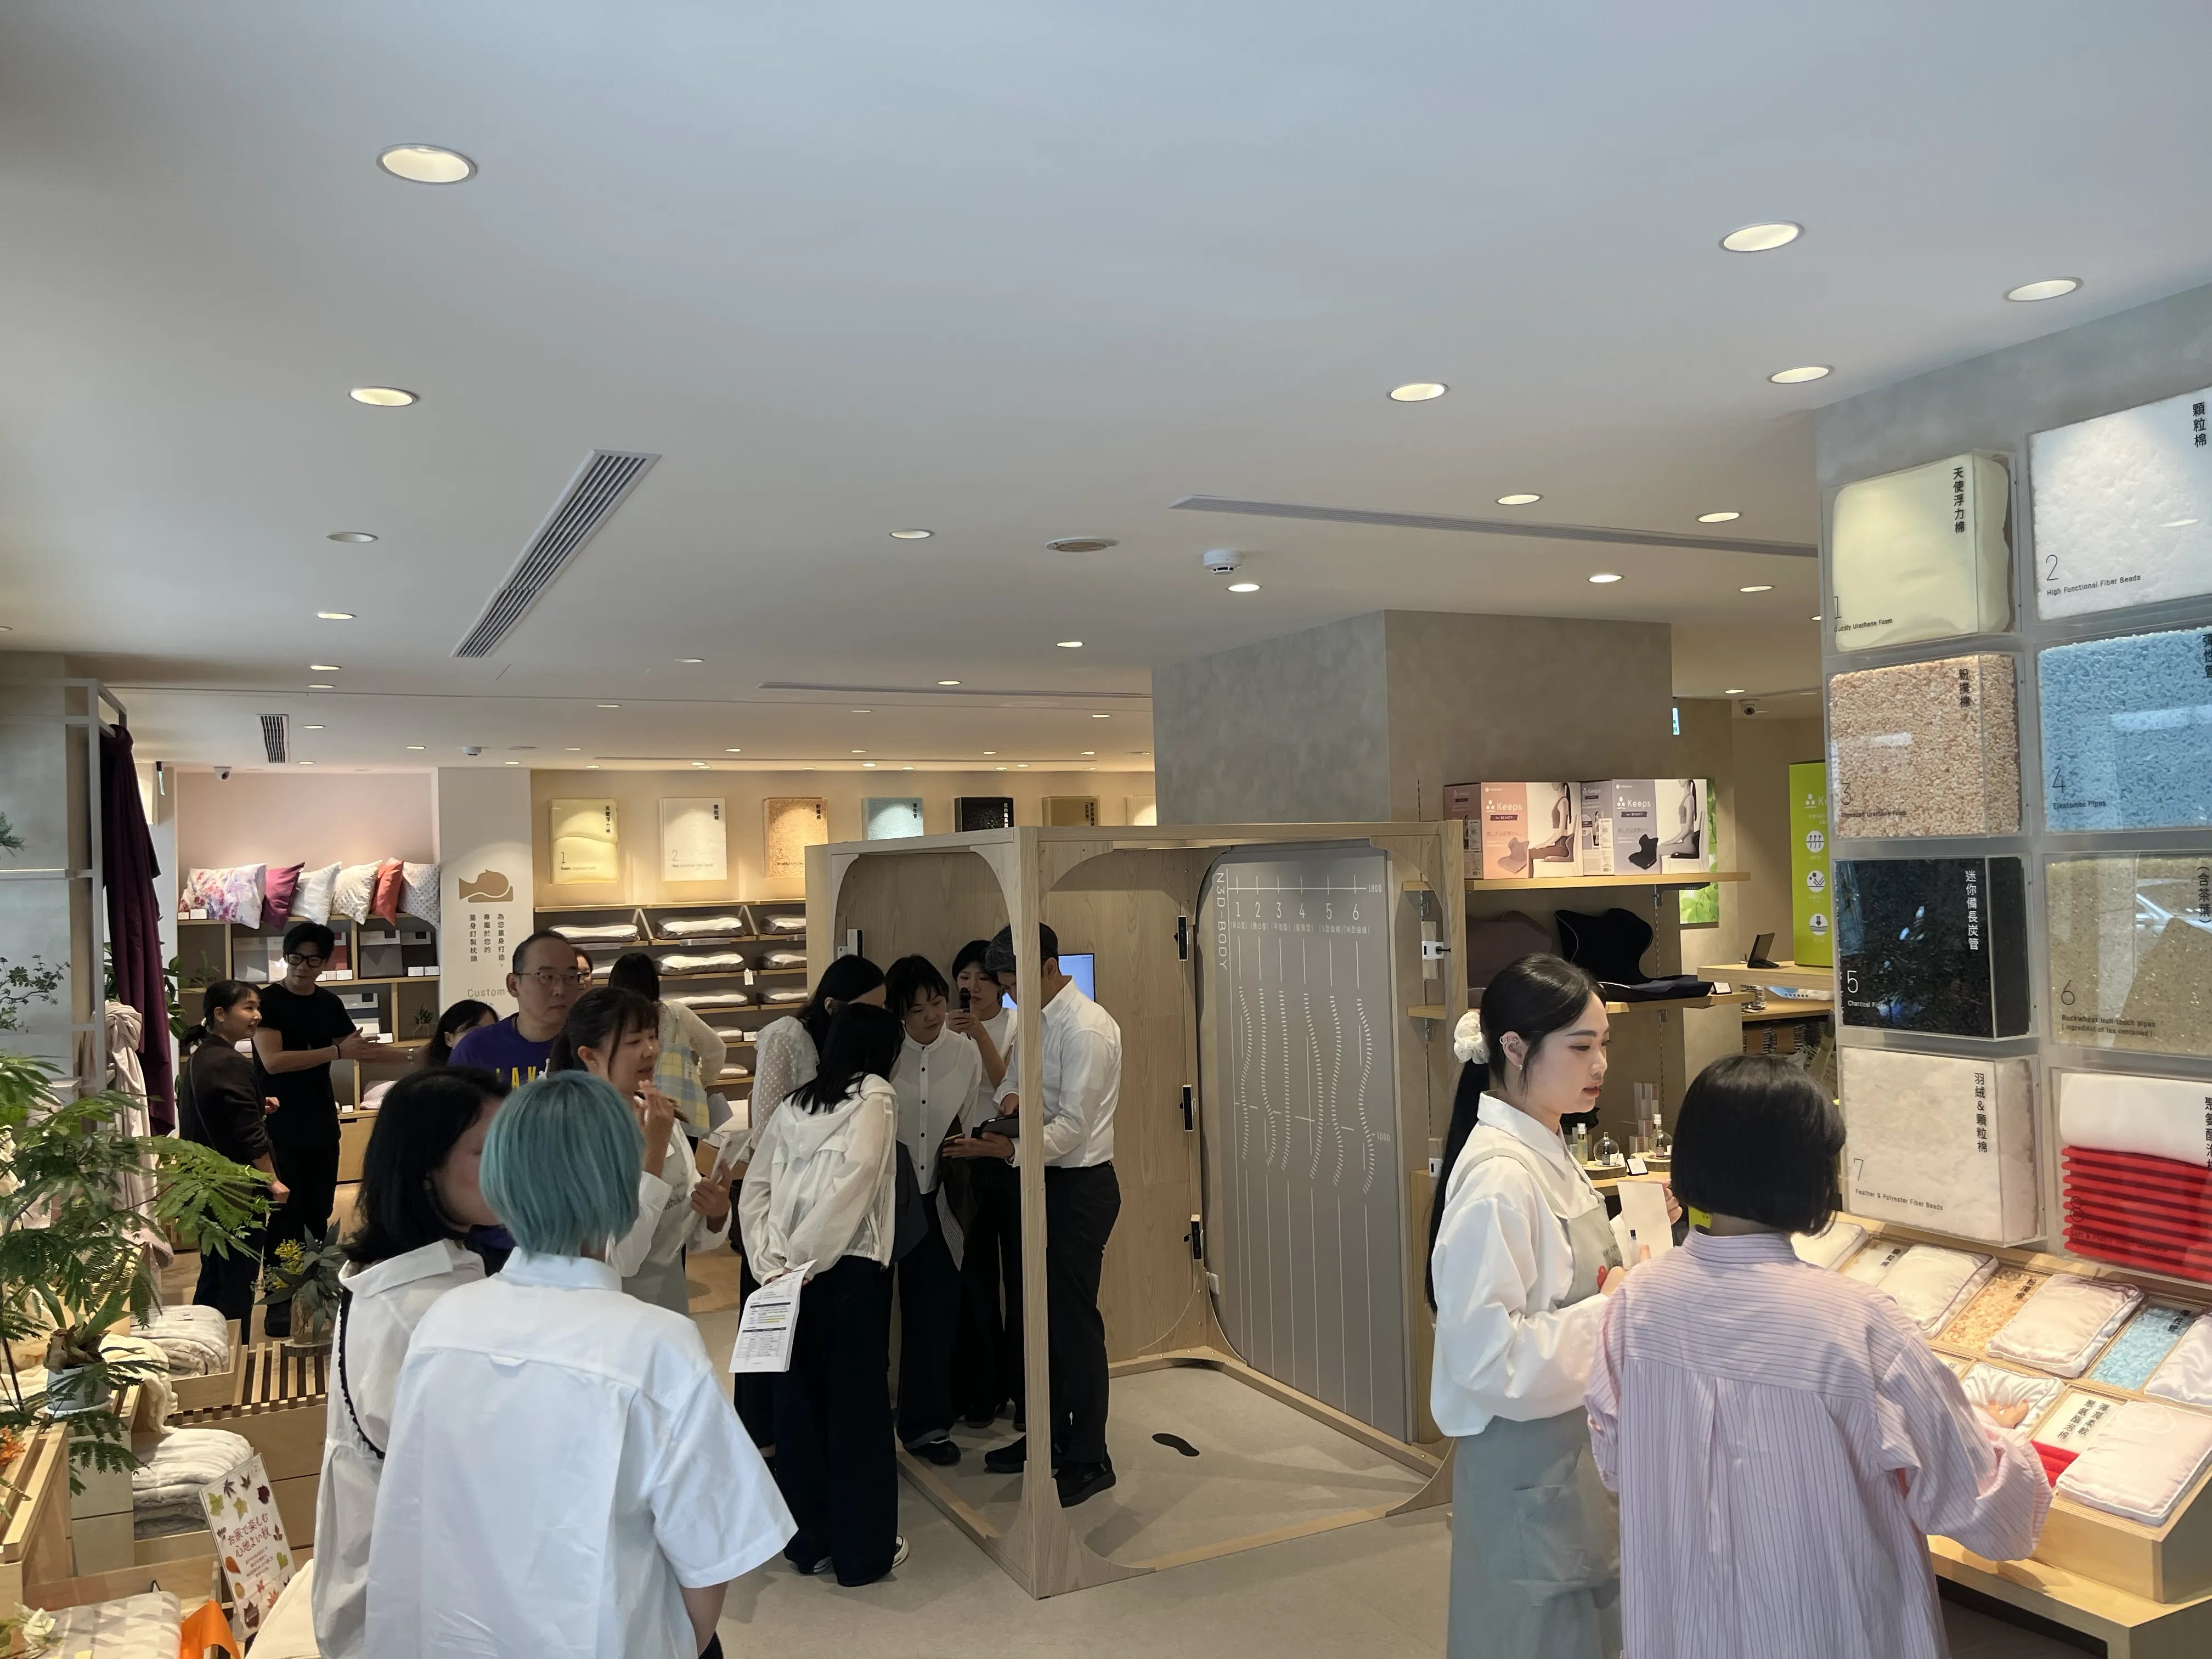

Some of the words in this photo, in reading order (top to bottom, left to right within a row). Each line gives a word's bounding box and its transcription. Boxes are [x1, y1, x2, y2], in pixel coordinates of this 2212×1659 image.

[2192, 402, 2207, 448] 顆粒棉
[1953, 466, 1965, 534] 天使浮力棉
[2046, 554, 2058, 580] 2
[2047, 588, 2061, 596] High
[2063, 581, 2098, 593] Functional
[2120, 574, 2141, 584] Beads
[1833, 596, 1842, 619] 1
[2052, 768, 2066, 793] 4
[1627, 799, 1651, 809] Keeps
[1841, 782, 1851, 805] 3
[1497, 802, 1522, 812] Keeps
[561, 851, 566, 864] 1
[672, 849, 678, 861] 2
[1368, 884, 1382, 893] 1800
[1216, 872, 1227, 970] N3D-BODY
[1235, 901, 1240, 917] 1
[1255, 901, 1261, 918] 2
[1276, 902, 1282, 918] 3
[1299, 902, 1305, 919] 4
[1326, 902, 1332, 919] 5
[1352, 903, 1359, 921] 6
[1965, 870, 1979, 950] 迷你備長炭管
[1847, 970, 1859, 993] 5
[2061, 980, 2075, 1005] 6
[2062, 1014, 2098, 1023] Buckwheat
[1974, 1073, 1988, 1153] 羽絨&顆粒棉
[1376, 1131, 1391, 1142] 1000
[1854, 1158, 1864, 1181] 7
[1855, 1188, 1875, 1198] Feather
[1883, 1193, 1908, 1204] Polyester
[1910, 1199, 1924, 1207] Fiber
[1926, 1202, 1943, 1211] Beads
[2099, 1366, 2113, 1378] 4
[228, 1513, 268, 1546] お家で楽しむ
[235, 1526, 272, 1558] 心地よい秋
